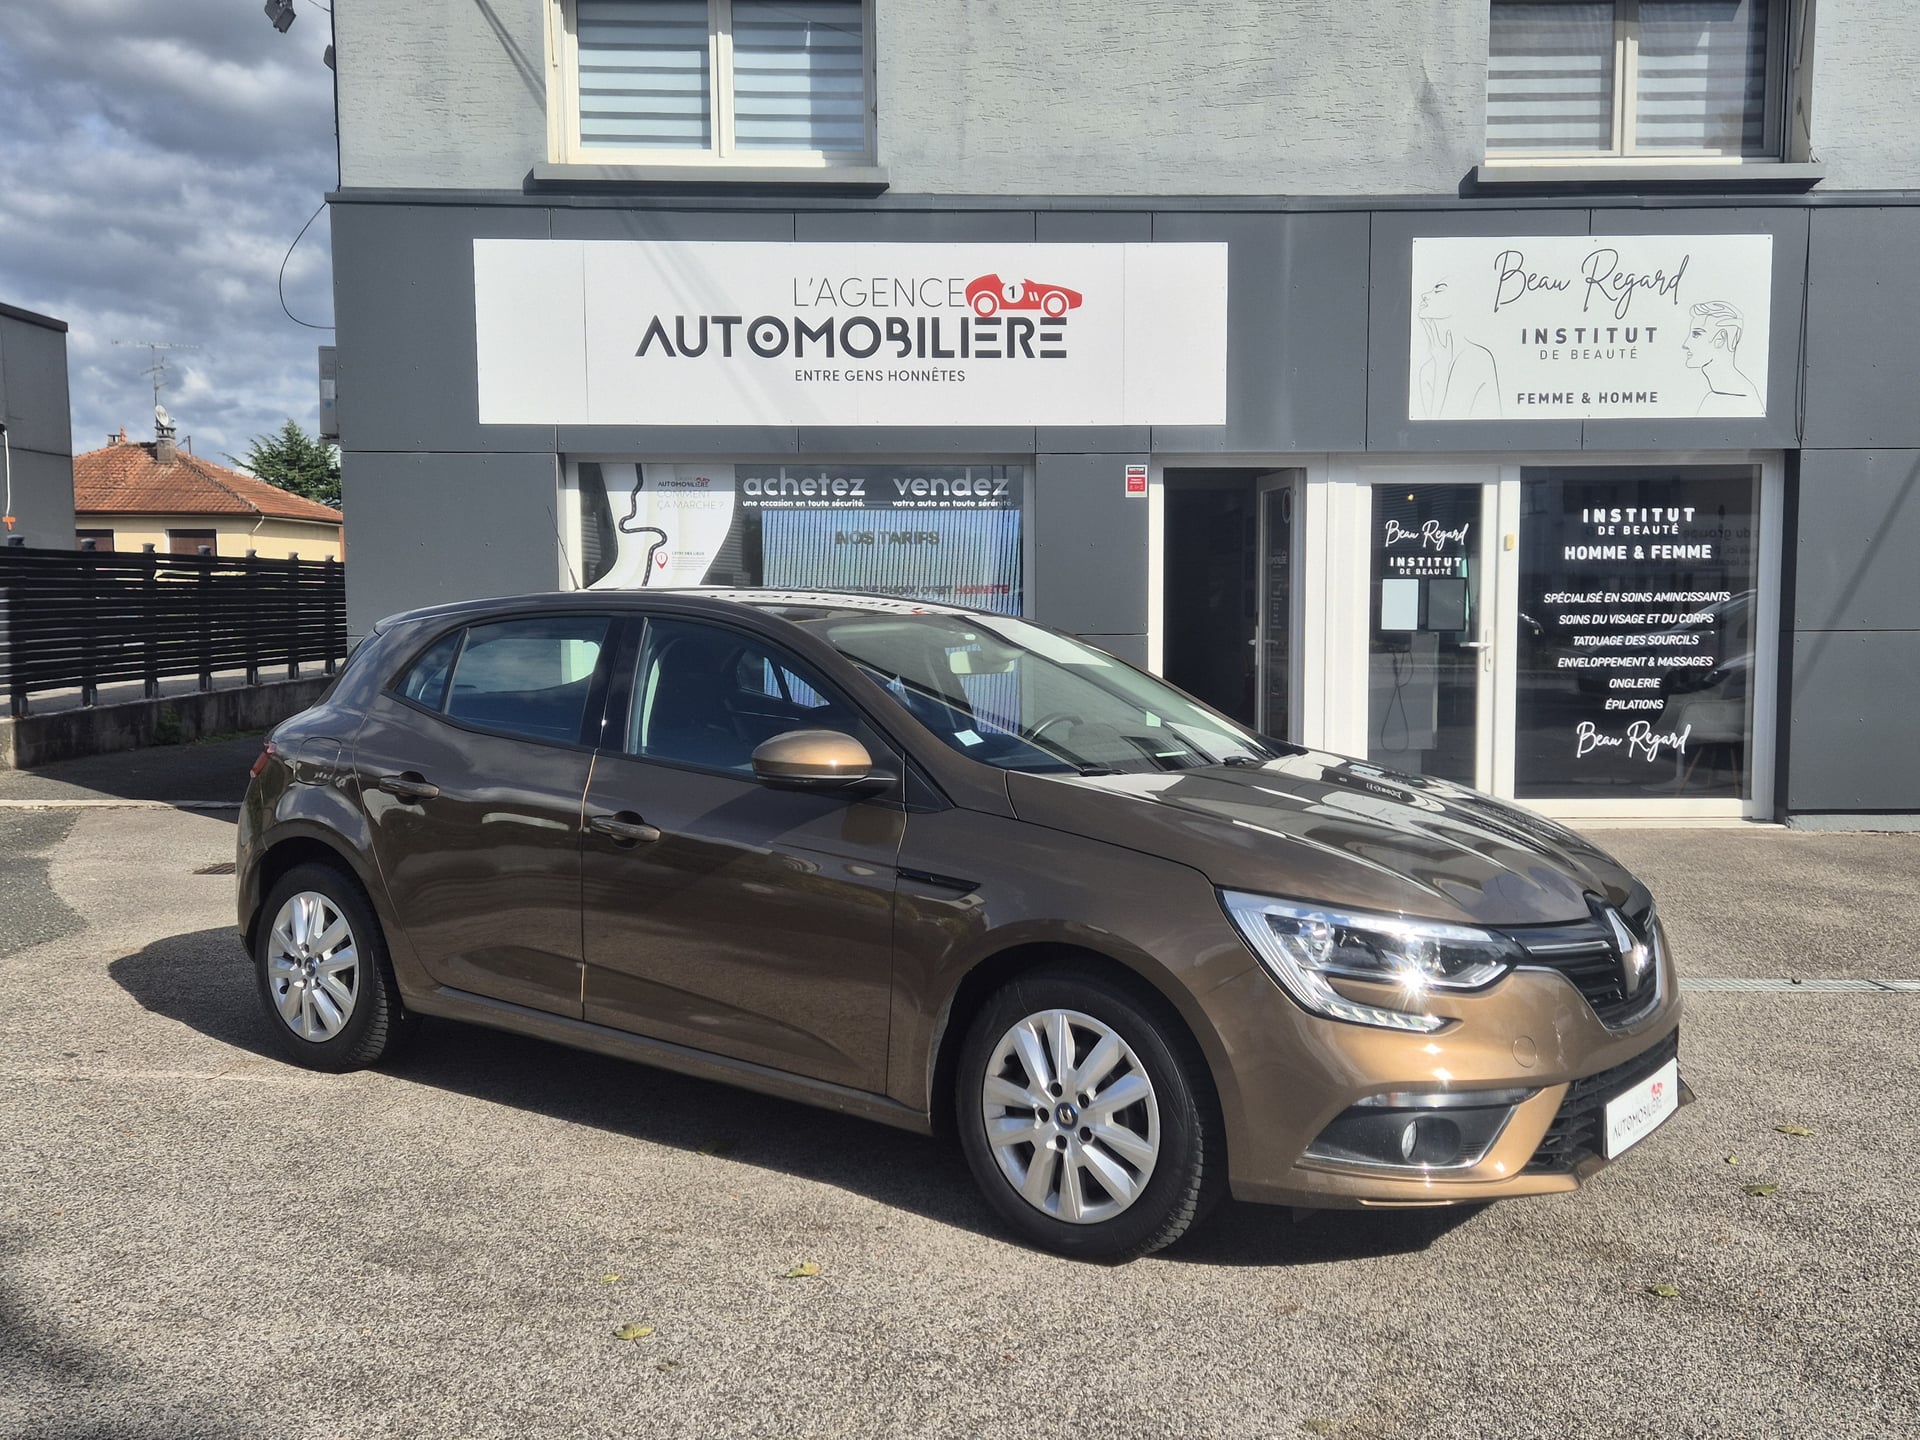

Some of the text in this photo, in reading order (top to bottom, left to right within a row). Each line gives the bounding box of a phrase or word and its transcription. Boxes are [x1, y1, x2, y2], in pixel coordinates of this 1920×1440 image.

[1493, 248, 1690, 319] Beau Regard
[793, 277, 965, 307] L'AGENCE
[1522, 327, 1658, 344] INSTITUT
[1540, 346, 1639, 360] DE BEAUTÉ
[795, 366, 966, 382] ENTRE GENS HONNÊTES
[1517, 392, 1658, 405] FEMME & HOMME
[743, 467, 866, 496] achetez
[893, 467, 1009, 496] vendez
[759, 499, 794, 507] occasion
[831, 499, 865, 507] sécurité.
[1582, 507, 1696, 523] INSTITUT
[1597, 522, 1680, 535] DE BEAUTÉ
[1385, 520, 1470, 551] Beau Regard
[1564, 545, 1628, 560] HOMME
[1633, 546, 1645, 560] &
[1651, 544, 1713, 559] FEMME
[1390, 557, 1462, 567] INSTITUT
[1415, 566, 1452, 575] BEAUTÉ
[1543, 591, 1731, 603] SPÉCIALISÉ EN SOINS AMINCISSANTS
[1559, 613, 1714, 624] SOINS DU VISAGE ET DU CORPS
[1573, 634, 1700, 646] TATOUAGE DES SOURCILS
[1557, 656, 1714, 668] ENVELOPPEMENT & MASSAGES
[1608, 677, 1662, 688] ONGLERIE
[1604, 697, 1665, 710] ÉPILATIONS
[1576, 720, 1692, 762] Beau Regard
